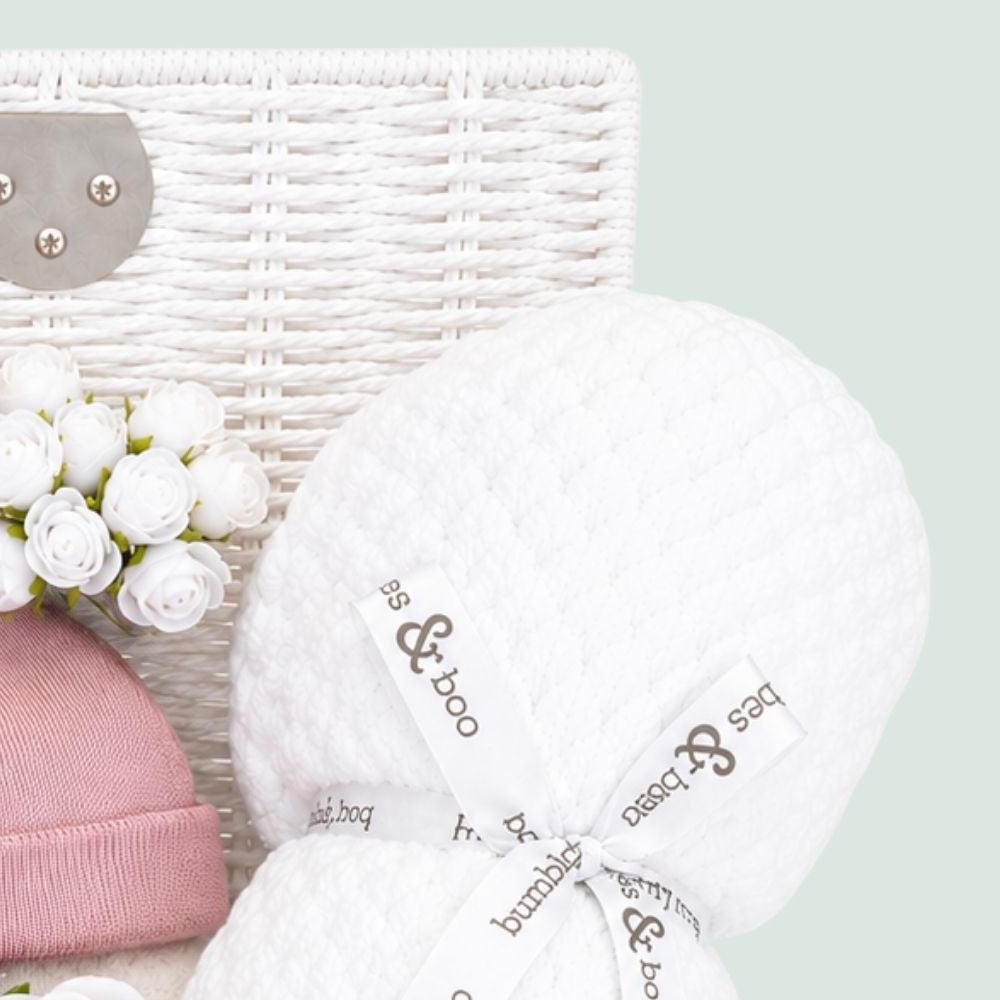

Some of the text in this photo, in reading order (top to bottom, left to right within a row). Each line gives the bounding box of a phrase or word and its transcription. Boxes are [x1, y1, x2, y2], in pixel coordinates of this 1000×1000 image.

[396, 613, 454, 676] &
[430, 667, 479, 738] boo
[673, 722, 737, 778] &
[622, 907, 666, 954] &
